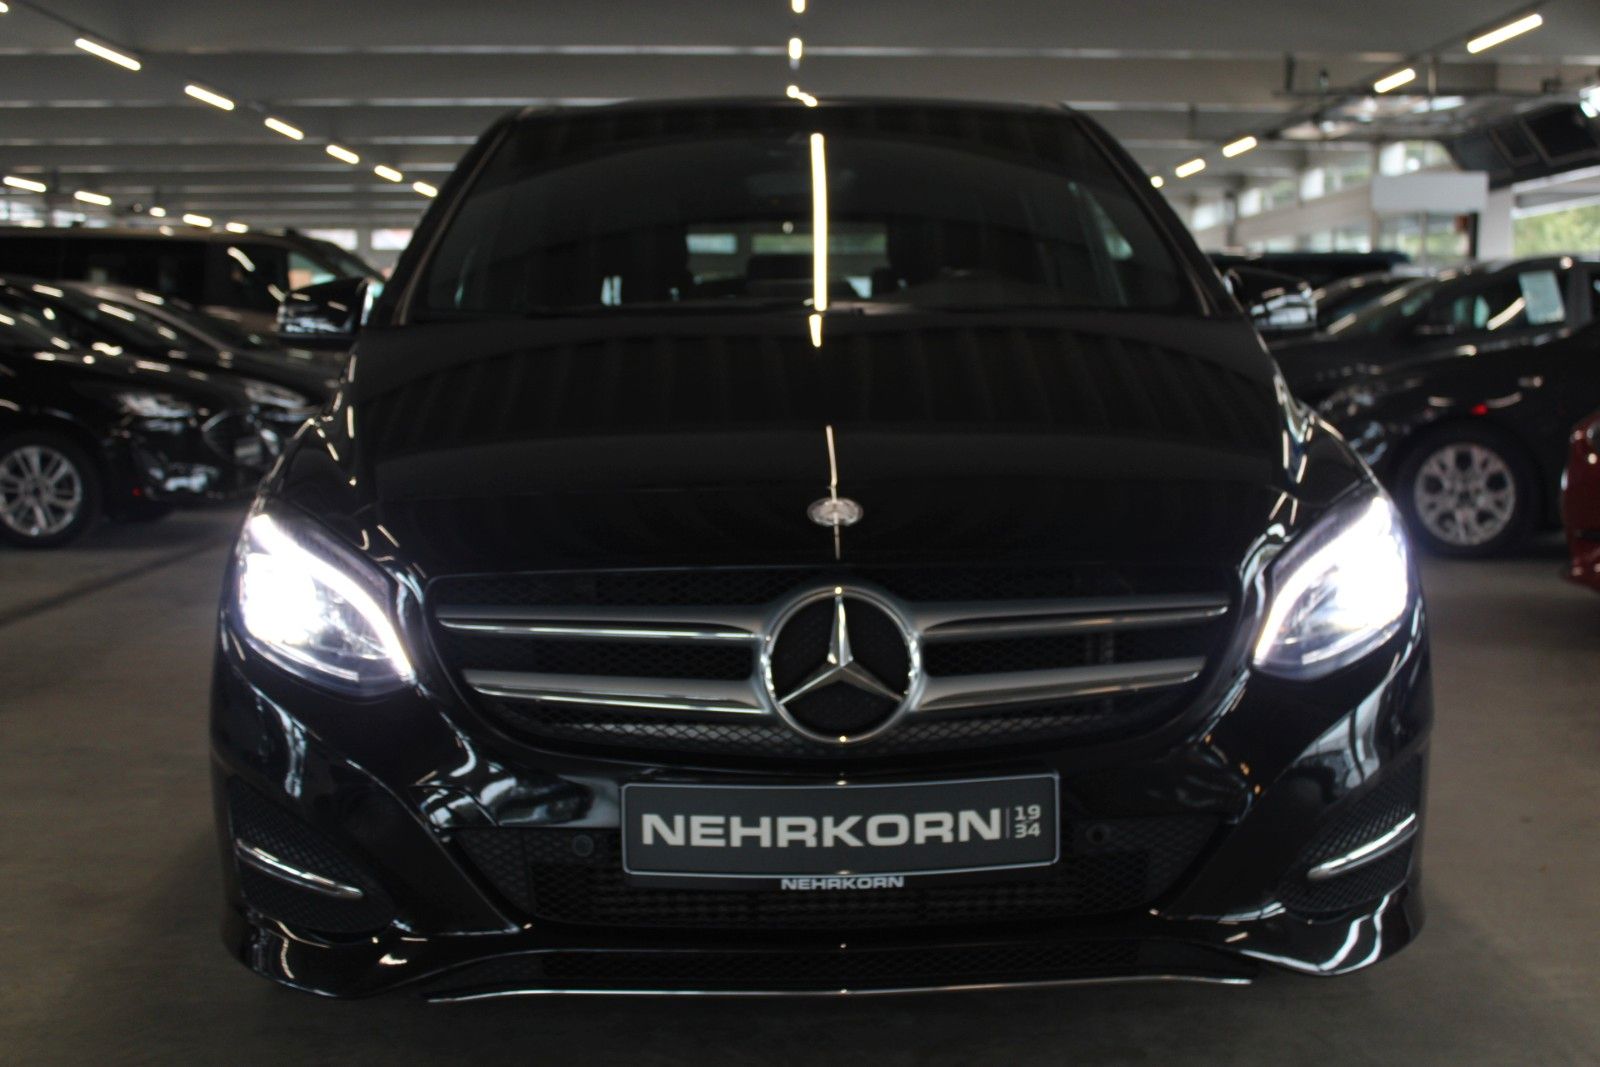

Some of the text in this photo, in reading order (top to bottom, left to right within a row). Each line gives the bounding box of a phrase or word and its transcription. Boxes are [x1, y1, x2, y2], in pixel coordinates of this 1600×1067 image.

[1014, 805, 1041, 821] 19
[641, 808, 1001, 848] NEHRKORN
[1014, 823, 1041, 838] 34
[781, 876, 904, 890] NEHRKORN
